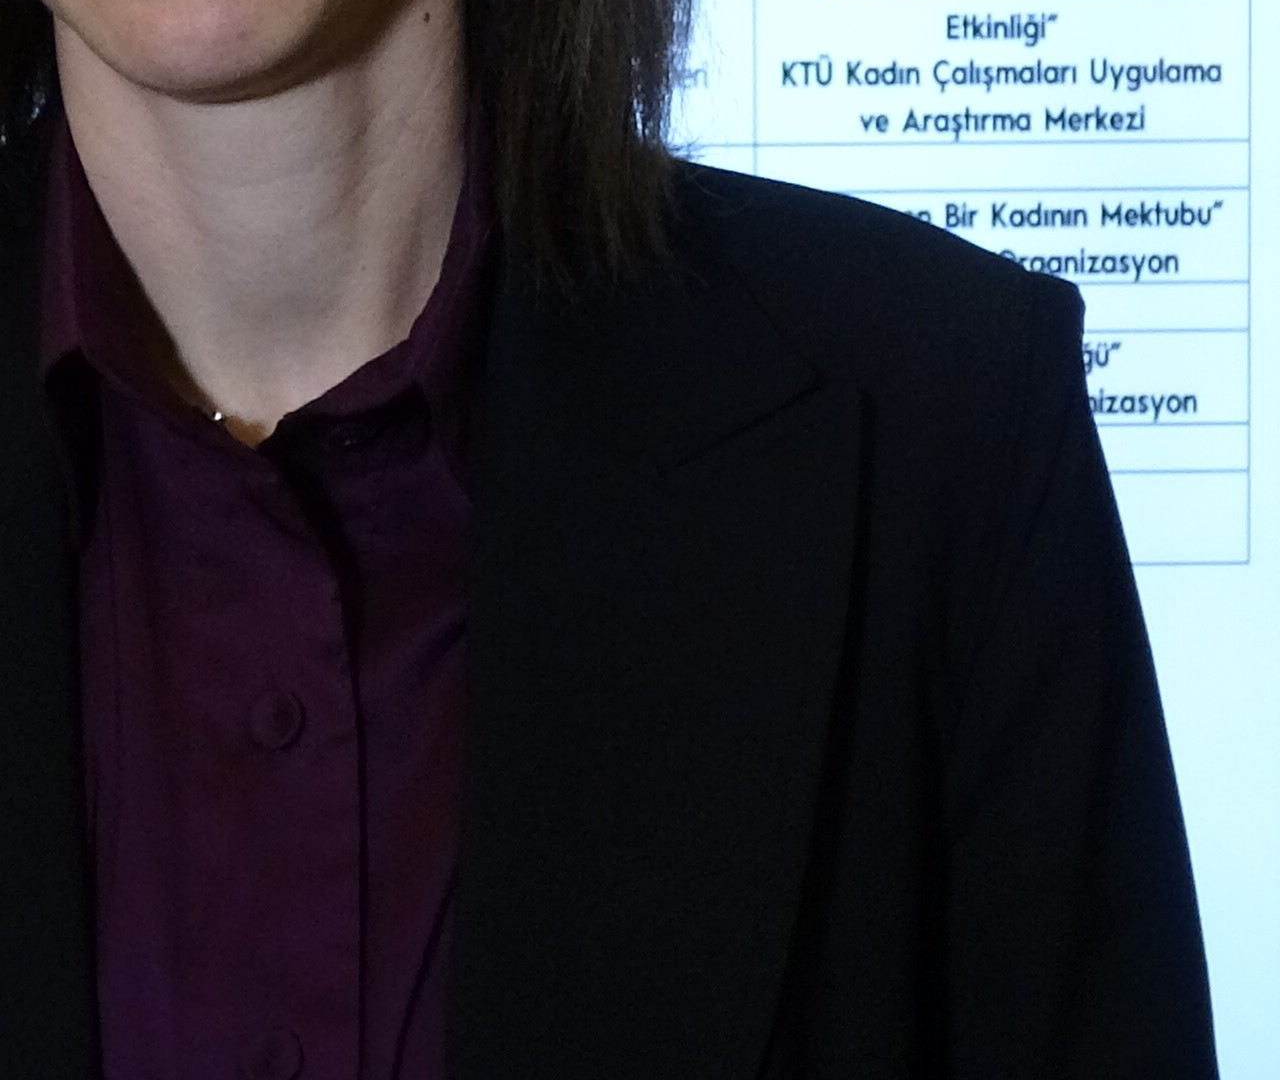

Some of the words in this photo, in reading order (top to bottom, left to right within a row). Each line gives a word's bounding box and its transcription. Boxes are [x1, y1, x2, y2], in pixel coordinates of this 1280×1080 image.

[782, 54, 833, 86] KTÜ
[846, 59, 920, 86] Kadın
[933, 58, 1077, 93] Çalışmaları
[1091, 57, 1222, 91] Uygulama
[860, 114, 889, 133] ve
[902, 106, 1031, 142] Araştırma
[1045, 104, 1145, 132] Merkezi
[945, 202, 978, 228] Bir
[991, 202, 1088, 228] Kadının
[1088, 387, 1198, 423] nizasyon
